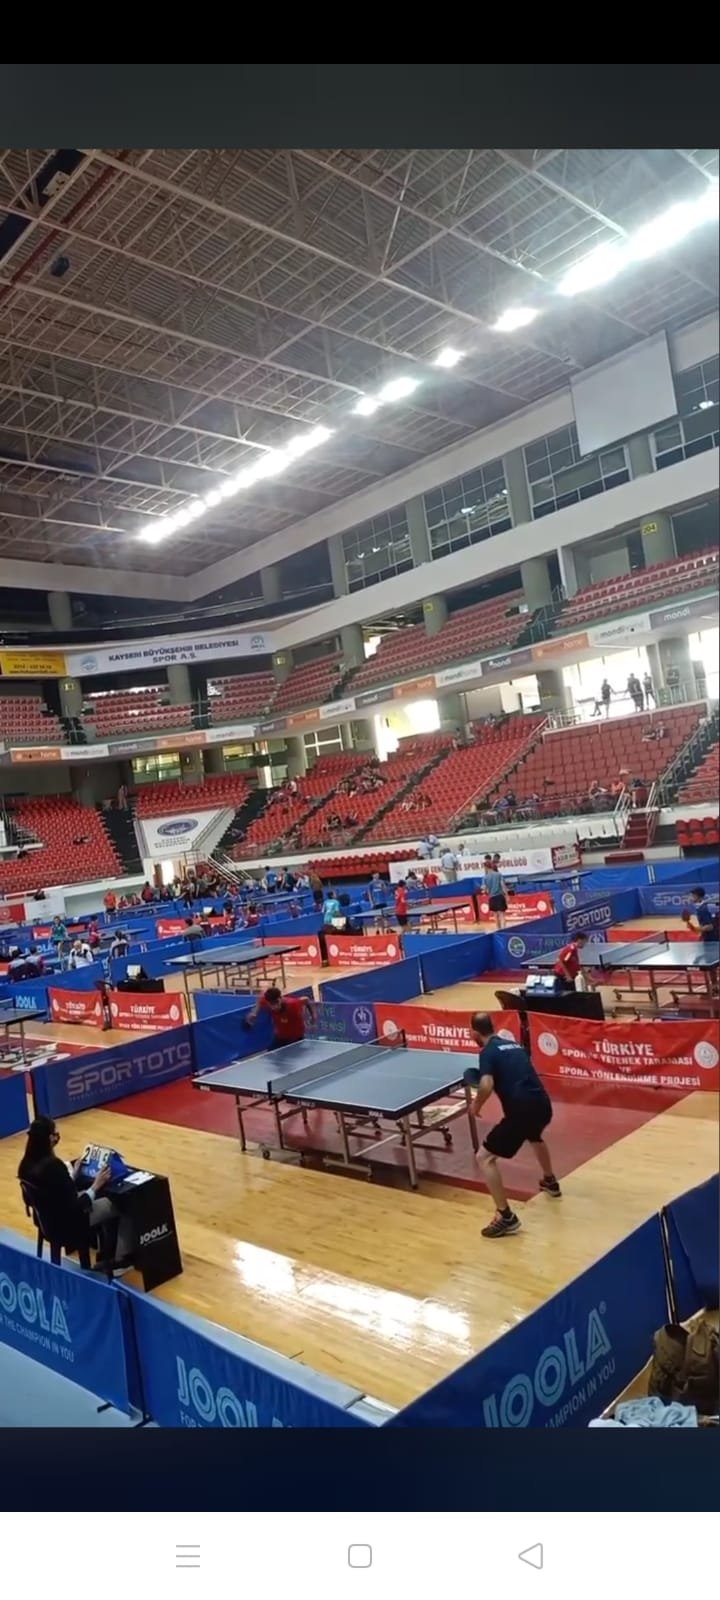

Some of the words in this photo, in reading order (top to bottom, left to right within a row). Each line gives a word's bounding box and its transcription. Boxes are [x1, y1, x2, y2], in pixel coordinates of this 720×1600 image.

[152, 653, 177, 664] SPOR
[567, 905, 612, 931] SPORTOTO
[421, 1023, 471, 1039] TÜRKİYE
[592, 1038, 655, 1057] TÜRKİYE
[66, 1041, 192, 1097] SPORTOTO
[559, 1065, 590, 1077] SPORA
[660, 1075, 701, 1087] PROJESİ
[140, 1224, 169, 1245] JOOLA
[0, 1271, 72, 1344] OOLA
[61, 1346, 75, 1363] YOU
[586, 1377, 598, 1398] IN
[597, 1358, 616, 1385] YOU
